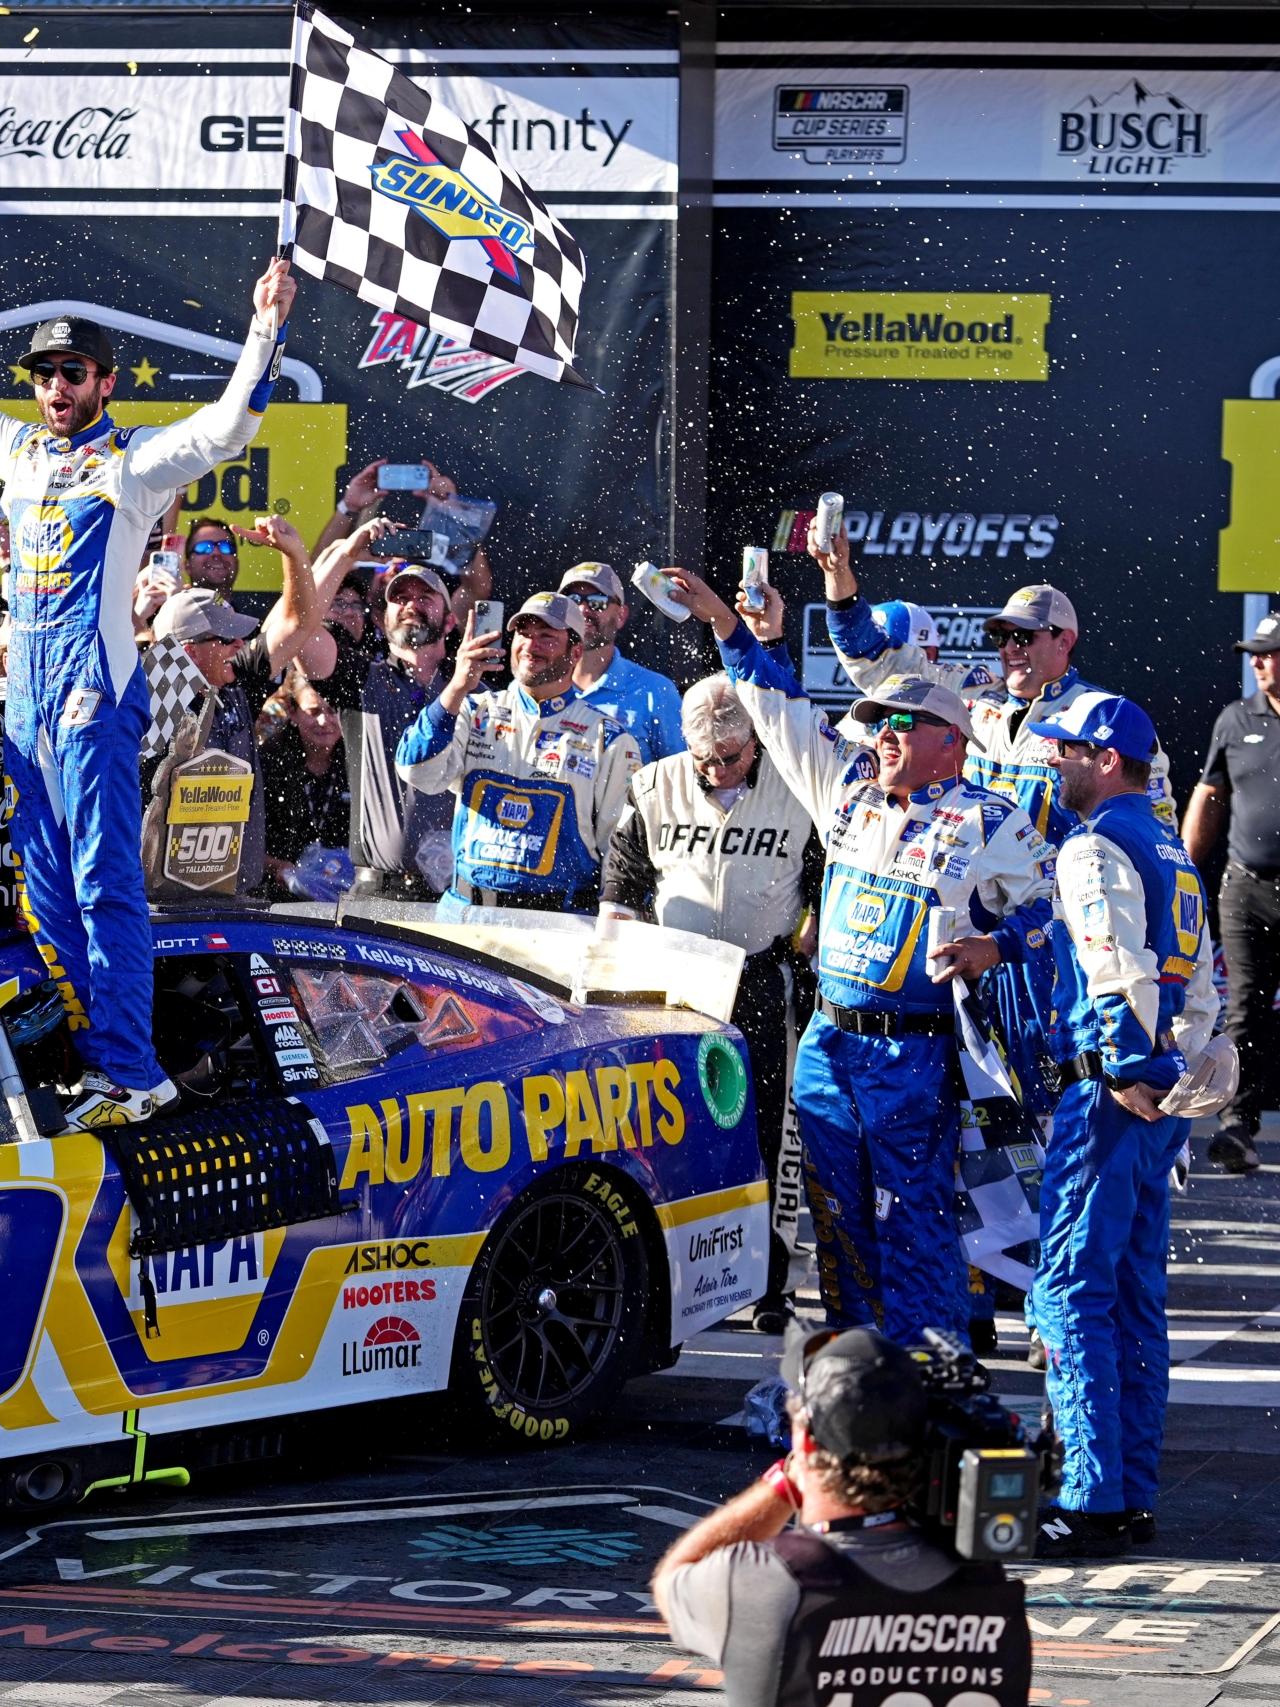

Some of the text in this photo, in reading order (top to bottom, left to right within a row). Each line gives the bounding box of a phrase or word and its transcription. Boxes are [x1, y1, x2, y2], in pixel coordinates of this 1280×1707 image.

[816, 91, 888, 111] NASCAR
[791, 118, 887, 136] CUP SERIES
[1058, 110, 1209, 156] BUSCH
[825, 149, 885, 161] PLAYOFFS
[1088, 156, 1172, 176] LIGHT
[377, 162, 526, 248] SUNOCO
[820, 312, 1014, 344] YellaWood
[824, 344, 1014, 362] Pressure Treated Pine
[179, 786, 243, 804] YellaWood
[501, 800, 529, 821] NAPA
[177, 825, 234, 864] 500
[657, 823, 790, 859] OFFICIAL
[185, 865, 224, 873] TALLADEGA
[946, 861, 963, 872] Blue
[948, 856, 970, 867] Kelley
[851, 901, 882, 924] NAPA
[1028, 932, 1044, 945] NAPA
[250, 968, 275, 976] AXALTA
[355, 944, 506, 998] Kelley Blue Book
[263, 1011, 296, 1021] HOOTERS
[274, 1025, 302, 1043] MAC
[276, 1040, 304, 1048] TOOLS
[281, 1053, 309, 1062] SIEMENS
[338, 1057, 687, 1190] AUTO PARTS
[583, 1172, 639, 1239] EAGLE
[688, 1223, 744, 1263] UniFirst
[344, 1241, 432, 1275] ASHOC
[720, 1266, 738, 1287] Tire
[342, 1280, 437, 1310] HOOTERS
[681, 1302, 706, 1318] HONORARY
[713, 1295, 729, 1307] CREW
[729, 1289, 753, 1303] MEMBER
[342, 1340, 423, 1378] LLumar
[856, 1613, 1007, 1655] NASCAR
[817, 1665, 1004, 1691] PRODUCTIONS
